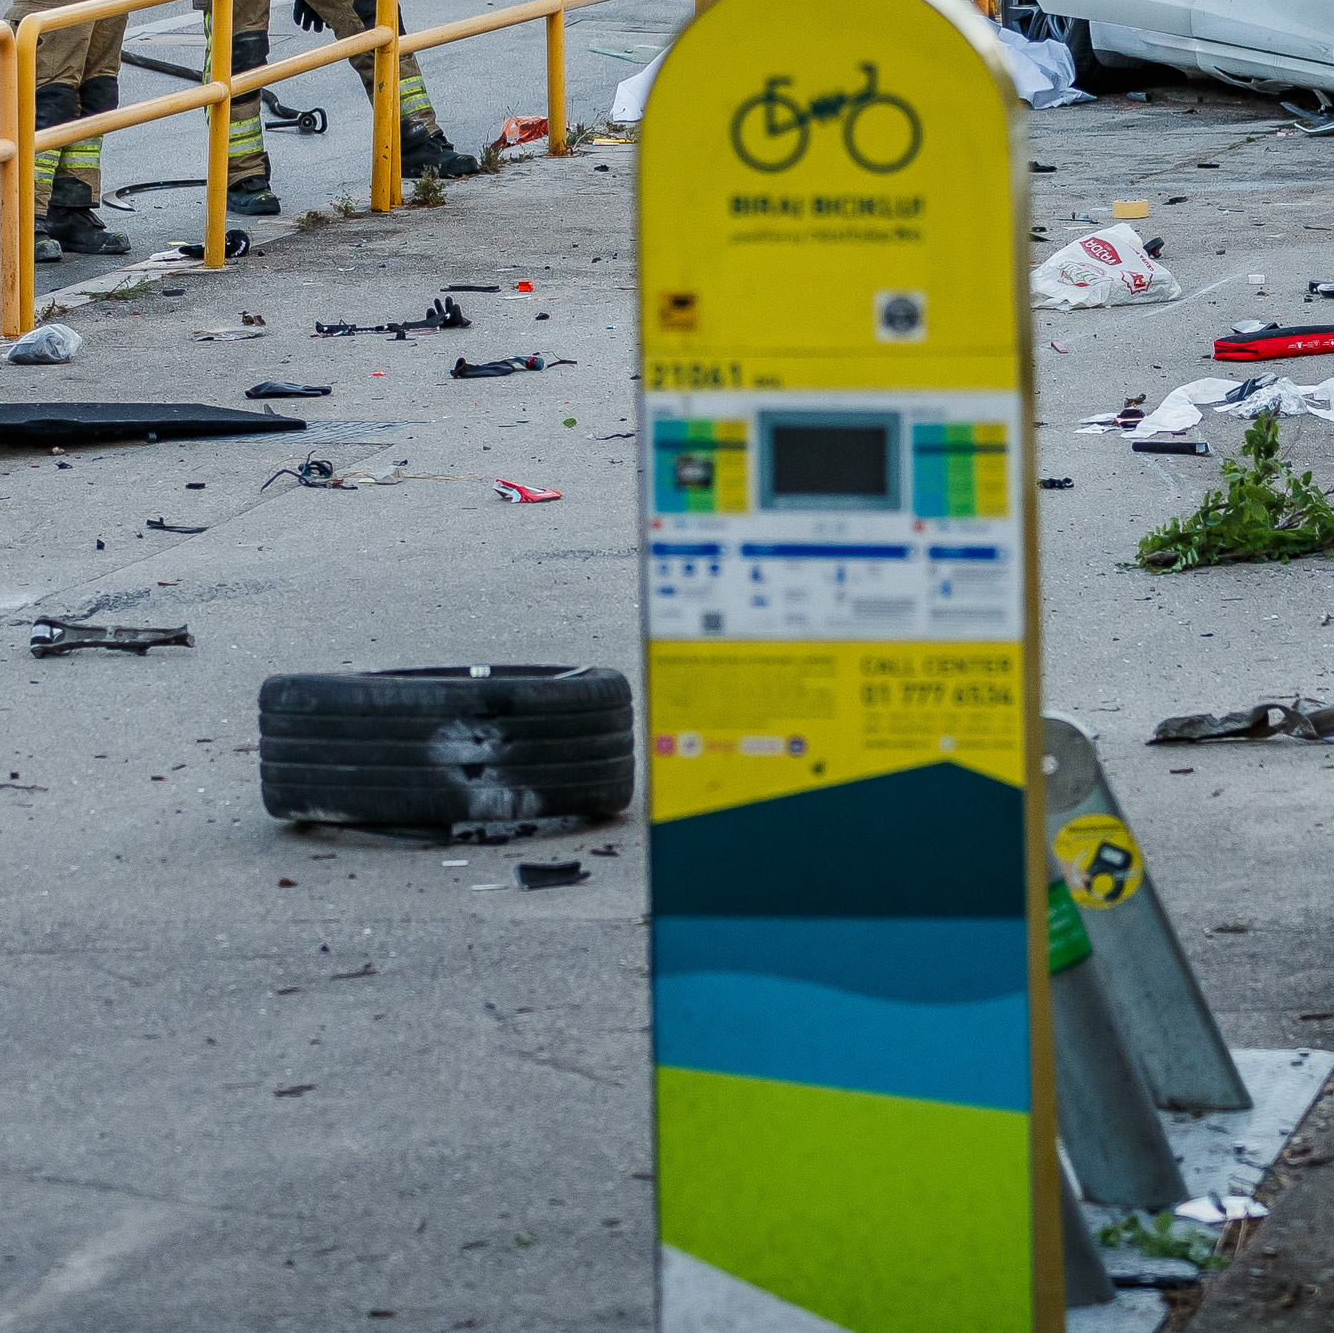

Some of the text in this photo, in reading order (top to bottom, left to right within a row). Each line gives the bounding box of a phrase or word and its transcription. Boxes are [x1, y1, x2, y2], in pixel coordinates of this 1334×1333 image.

[1084, 239, 1118, 265] VAJDA
[861, 656, 916, 678] CALL
[922, 655, 1013, 678] CENTER
